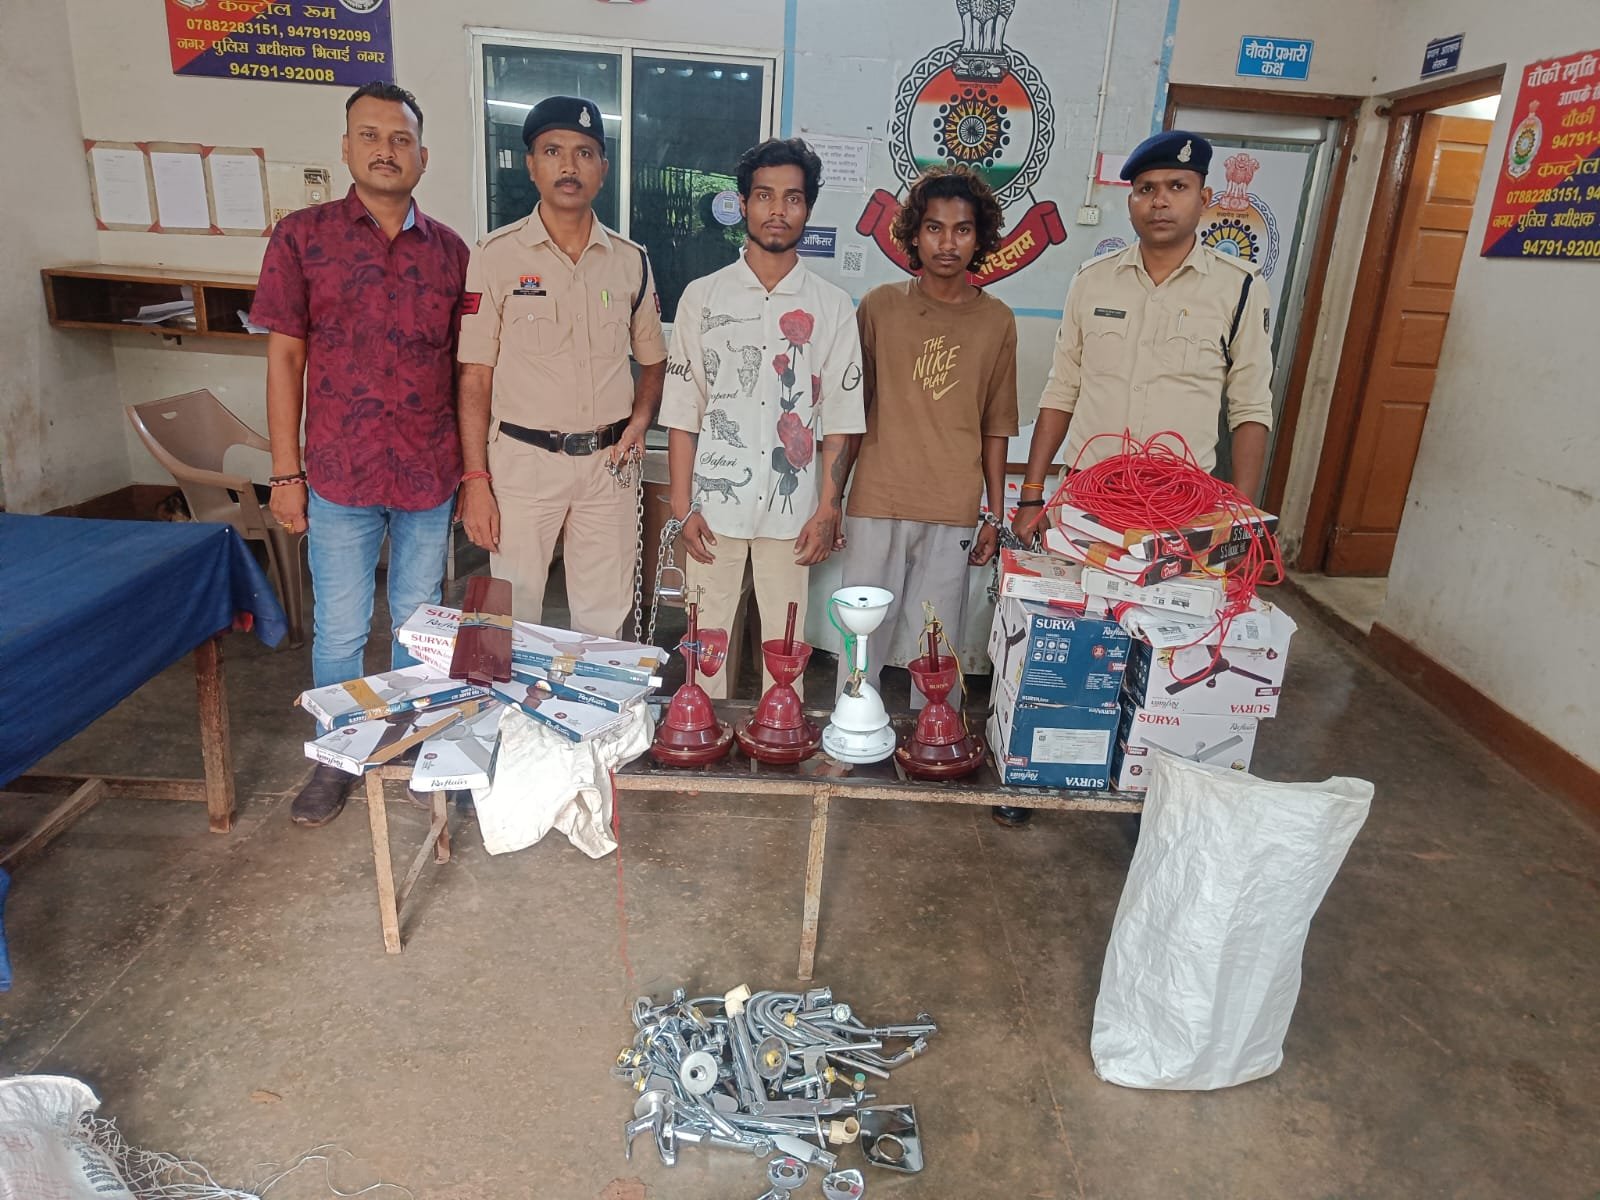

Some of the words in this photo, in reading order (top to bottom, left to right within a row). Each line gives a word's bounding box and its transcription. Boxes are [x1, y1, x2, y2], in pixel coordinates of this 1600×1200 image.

[303, 5, 337, 19] रूम
[186, 18, 284, 38] 07882283151,
[287, 25, 371, 42] 9479192099
[176, 37, 207, 51] नगर
[212, 37, 249, 56] पुलिस
[255, 40, 306, 57] अधीक्षक
[312, 43, 351, 62] भिलाई
[357, 50, 386, 63] नगर
[1245, 40, 1274, 60] चौकी
[1275, 44, 1308, 62] प्रभारी
[229, 62, 335, 82] 94791-92008
[1261, 61, 1285, 76] कक्ष
[1562, 54, 1599, 85] स्मृति
[1551, 130, 1600, 149] 94791-
[1506, 186, 1582, 204] 07882283151,
[1492, 214, 1516, 229] नगर
[1516, 208, 1549, 233] पुलिस
[1550, 207, 1596, 229] अधीक्षक
[923, 335, 946, 354] THE
[922, 371, 949, 391] PLAY
[699, 451, 738, 470] Safari
[425, 608, 462, 623] SUR
[1035, 618, 1076, 631] SURYA
[411, 633, 449, 647] SURYA
[1230, 704, 1271, 713] SURYA
[1138, 713, 1181, 726] SURYA
[1065, 776, 1105, 788] SURYA
